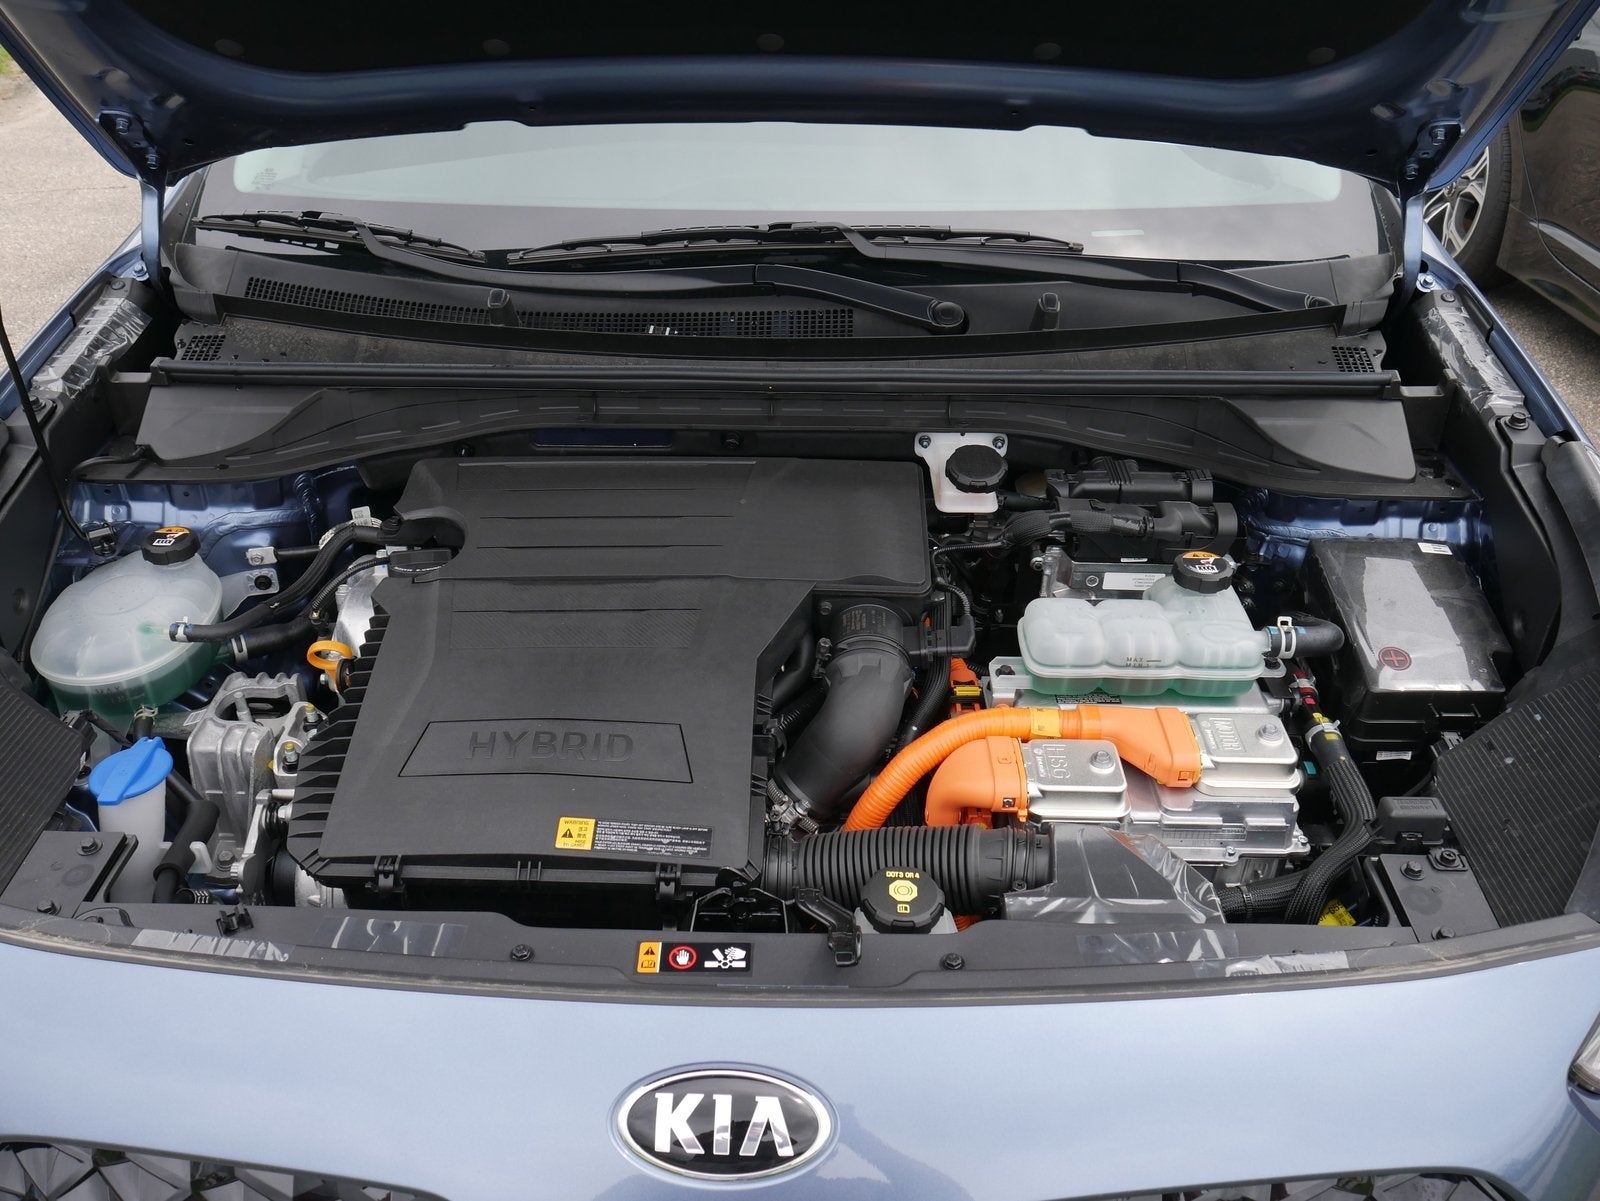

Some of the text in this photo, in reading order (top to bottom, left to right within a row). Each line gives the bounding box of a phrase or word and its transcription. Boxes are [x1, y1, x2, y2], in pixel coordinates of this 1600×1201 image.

[464, 730, 634, 762] HYBRID
[1212, 720, 1242, 751] MOTOR
[655, 1093, 794, 1157] KIA
